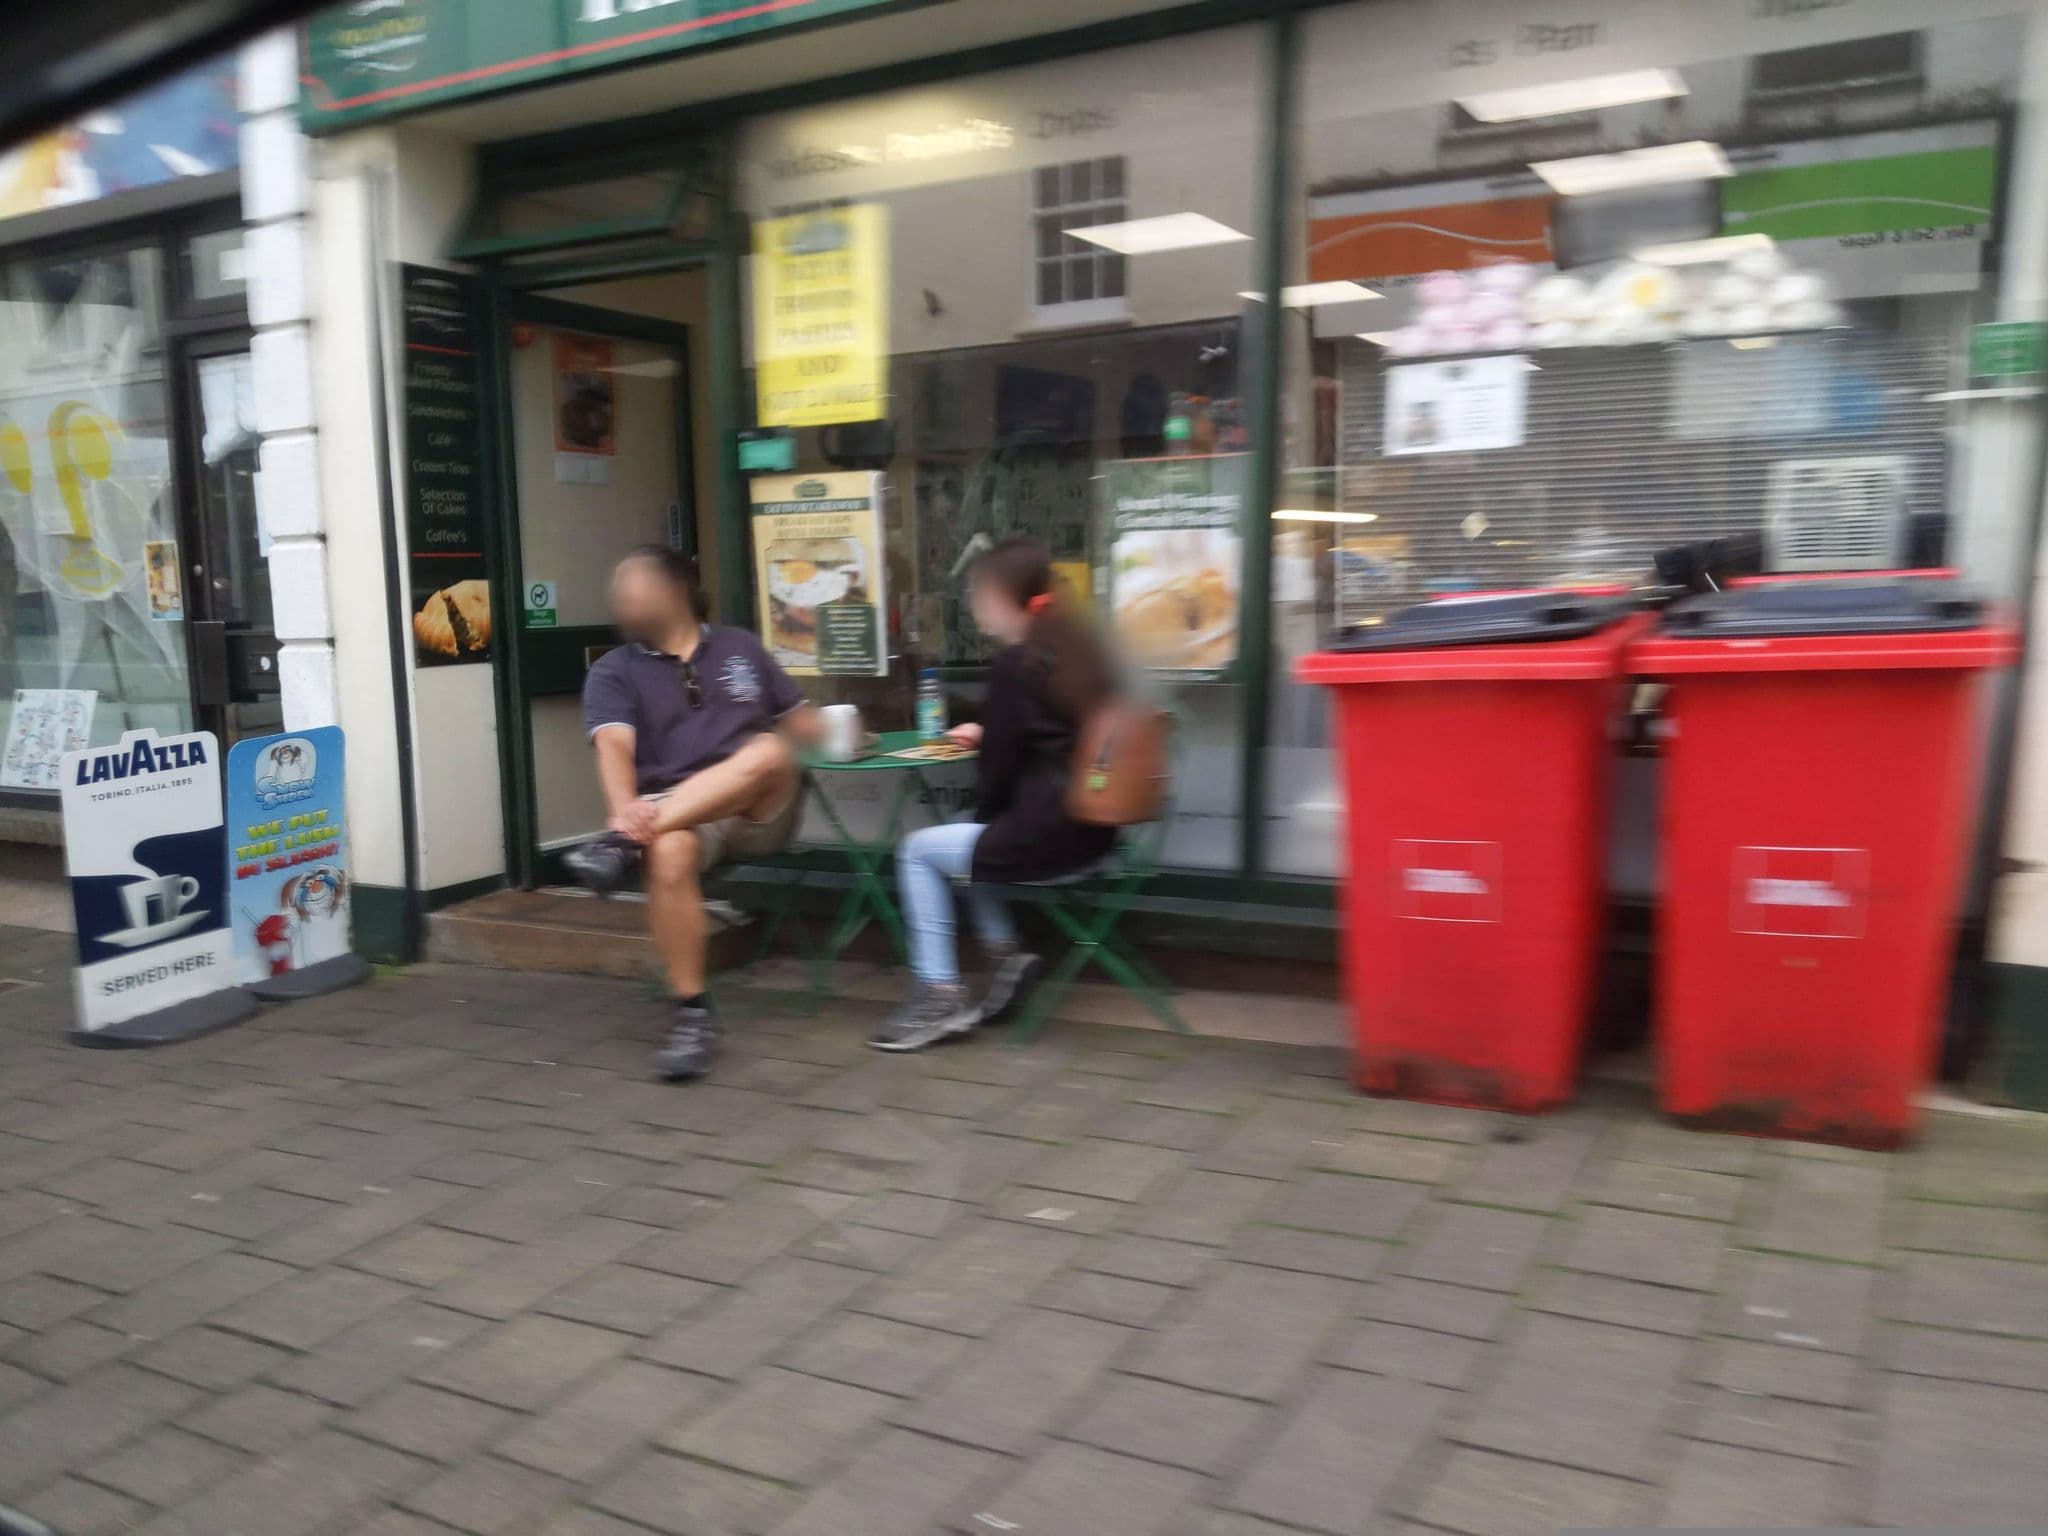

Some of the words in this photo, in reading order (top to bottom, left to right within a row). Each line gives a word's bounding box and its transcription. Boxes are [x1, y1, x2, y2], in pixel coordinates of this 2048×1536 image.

[412, 459, 446, 473] Cream
[419, 488, 467, 502] Selection
[422, 501, 435, 514] Of
[436, 502, 467, 515] Cakes
[425, 529, 467, 544] Coffee's
[75, 738, 207, 787] LAVAZZA
[171, 777, 193, 788] 1895
[248, 819, 285, 840] WE
[288, 809, 328, 831] PUT
[235, 838, 281, 862] THE
[103, 962, 169, 997] SERVED
[172, 951, 216, 976] HERE
